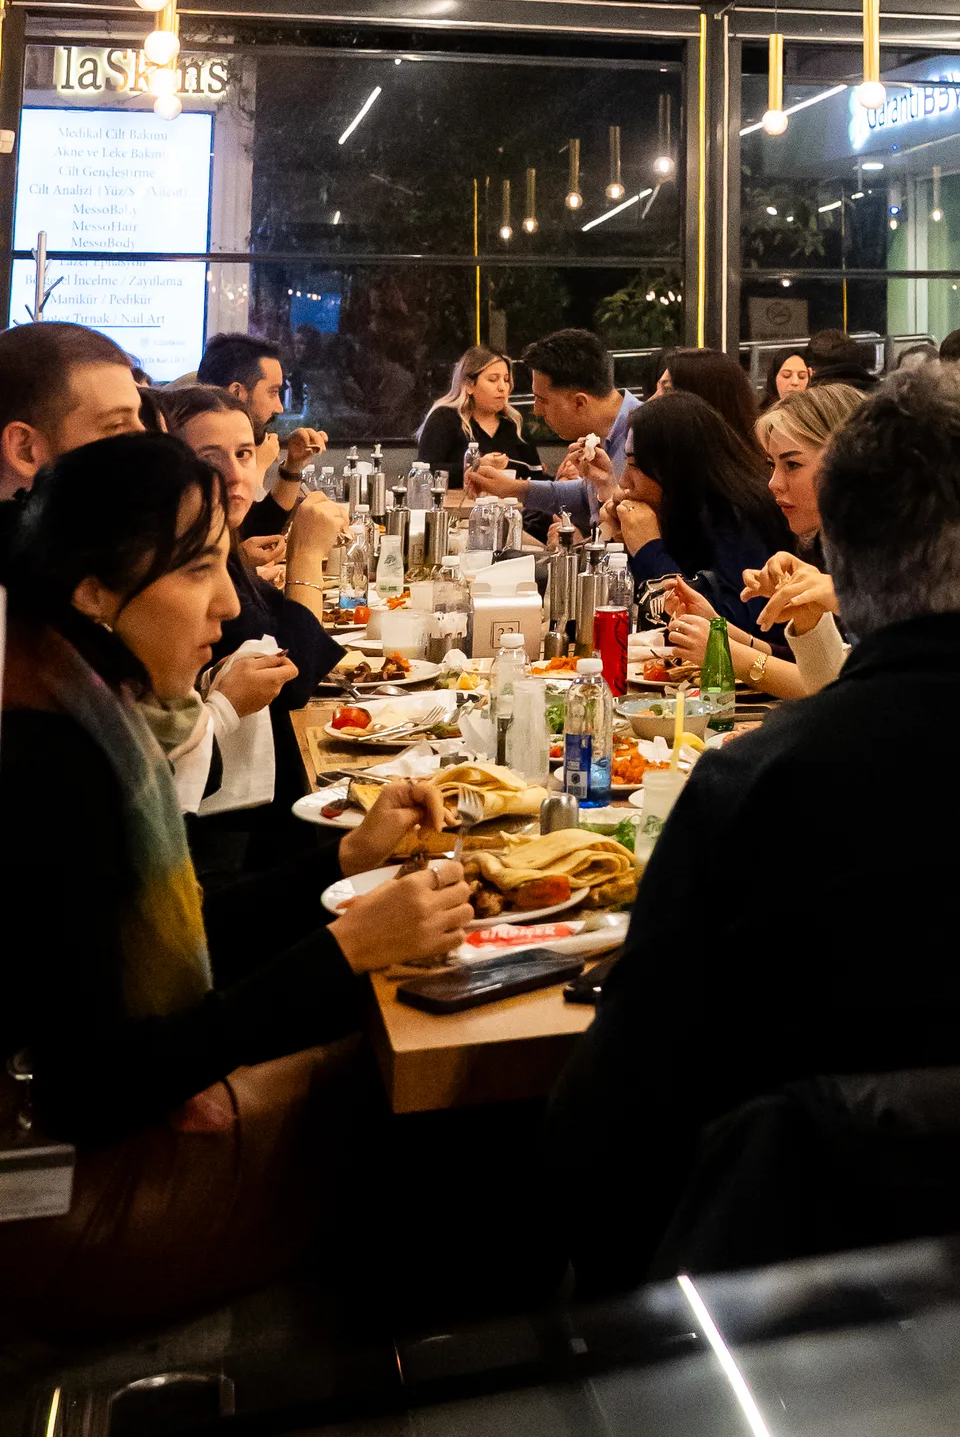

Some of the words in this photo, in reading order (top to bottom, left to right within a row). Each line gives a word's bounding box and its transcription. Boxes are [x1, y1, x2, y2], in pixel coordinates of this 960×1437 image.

[61, 47, 227, 94] laSkns
[105, 128, 125, 139] Cilt
[54, 146, 83, 157] Akne
[87, 149, 99, 157] ve
[102, 147, 127, 158] Leke
[58, 166, 79, 177] Cilt
[29, 184, 49, 195] Cilt
[53, 184, 92, 196] Analizi
[71, 220, 138, 232] MessoHair
[70, 237, 136, 250] MessoBody
[49, 294, 98, 305] Manikür
[109, 294, 153, 305] Pedikür
[121, 313, 144, 324] Nail
[148, 314, 165, 324] Art
